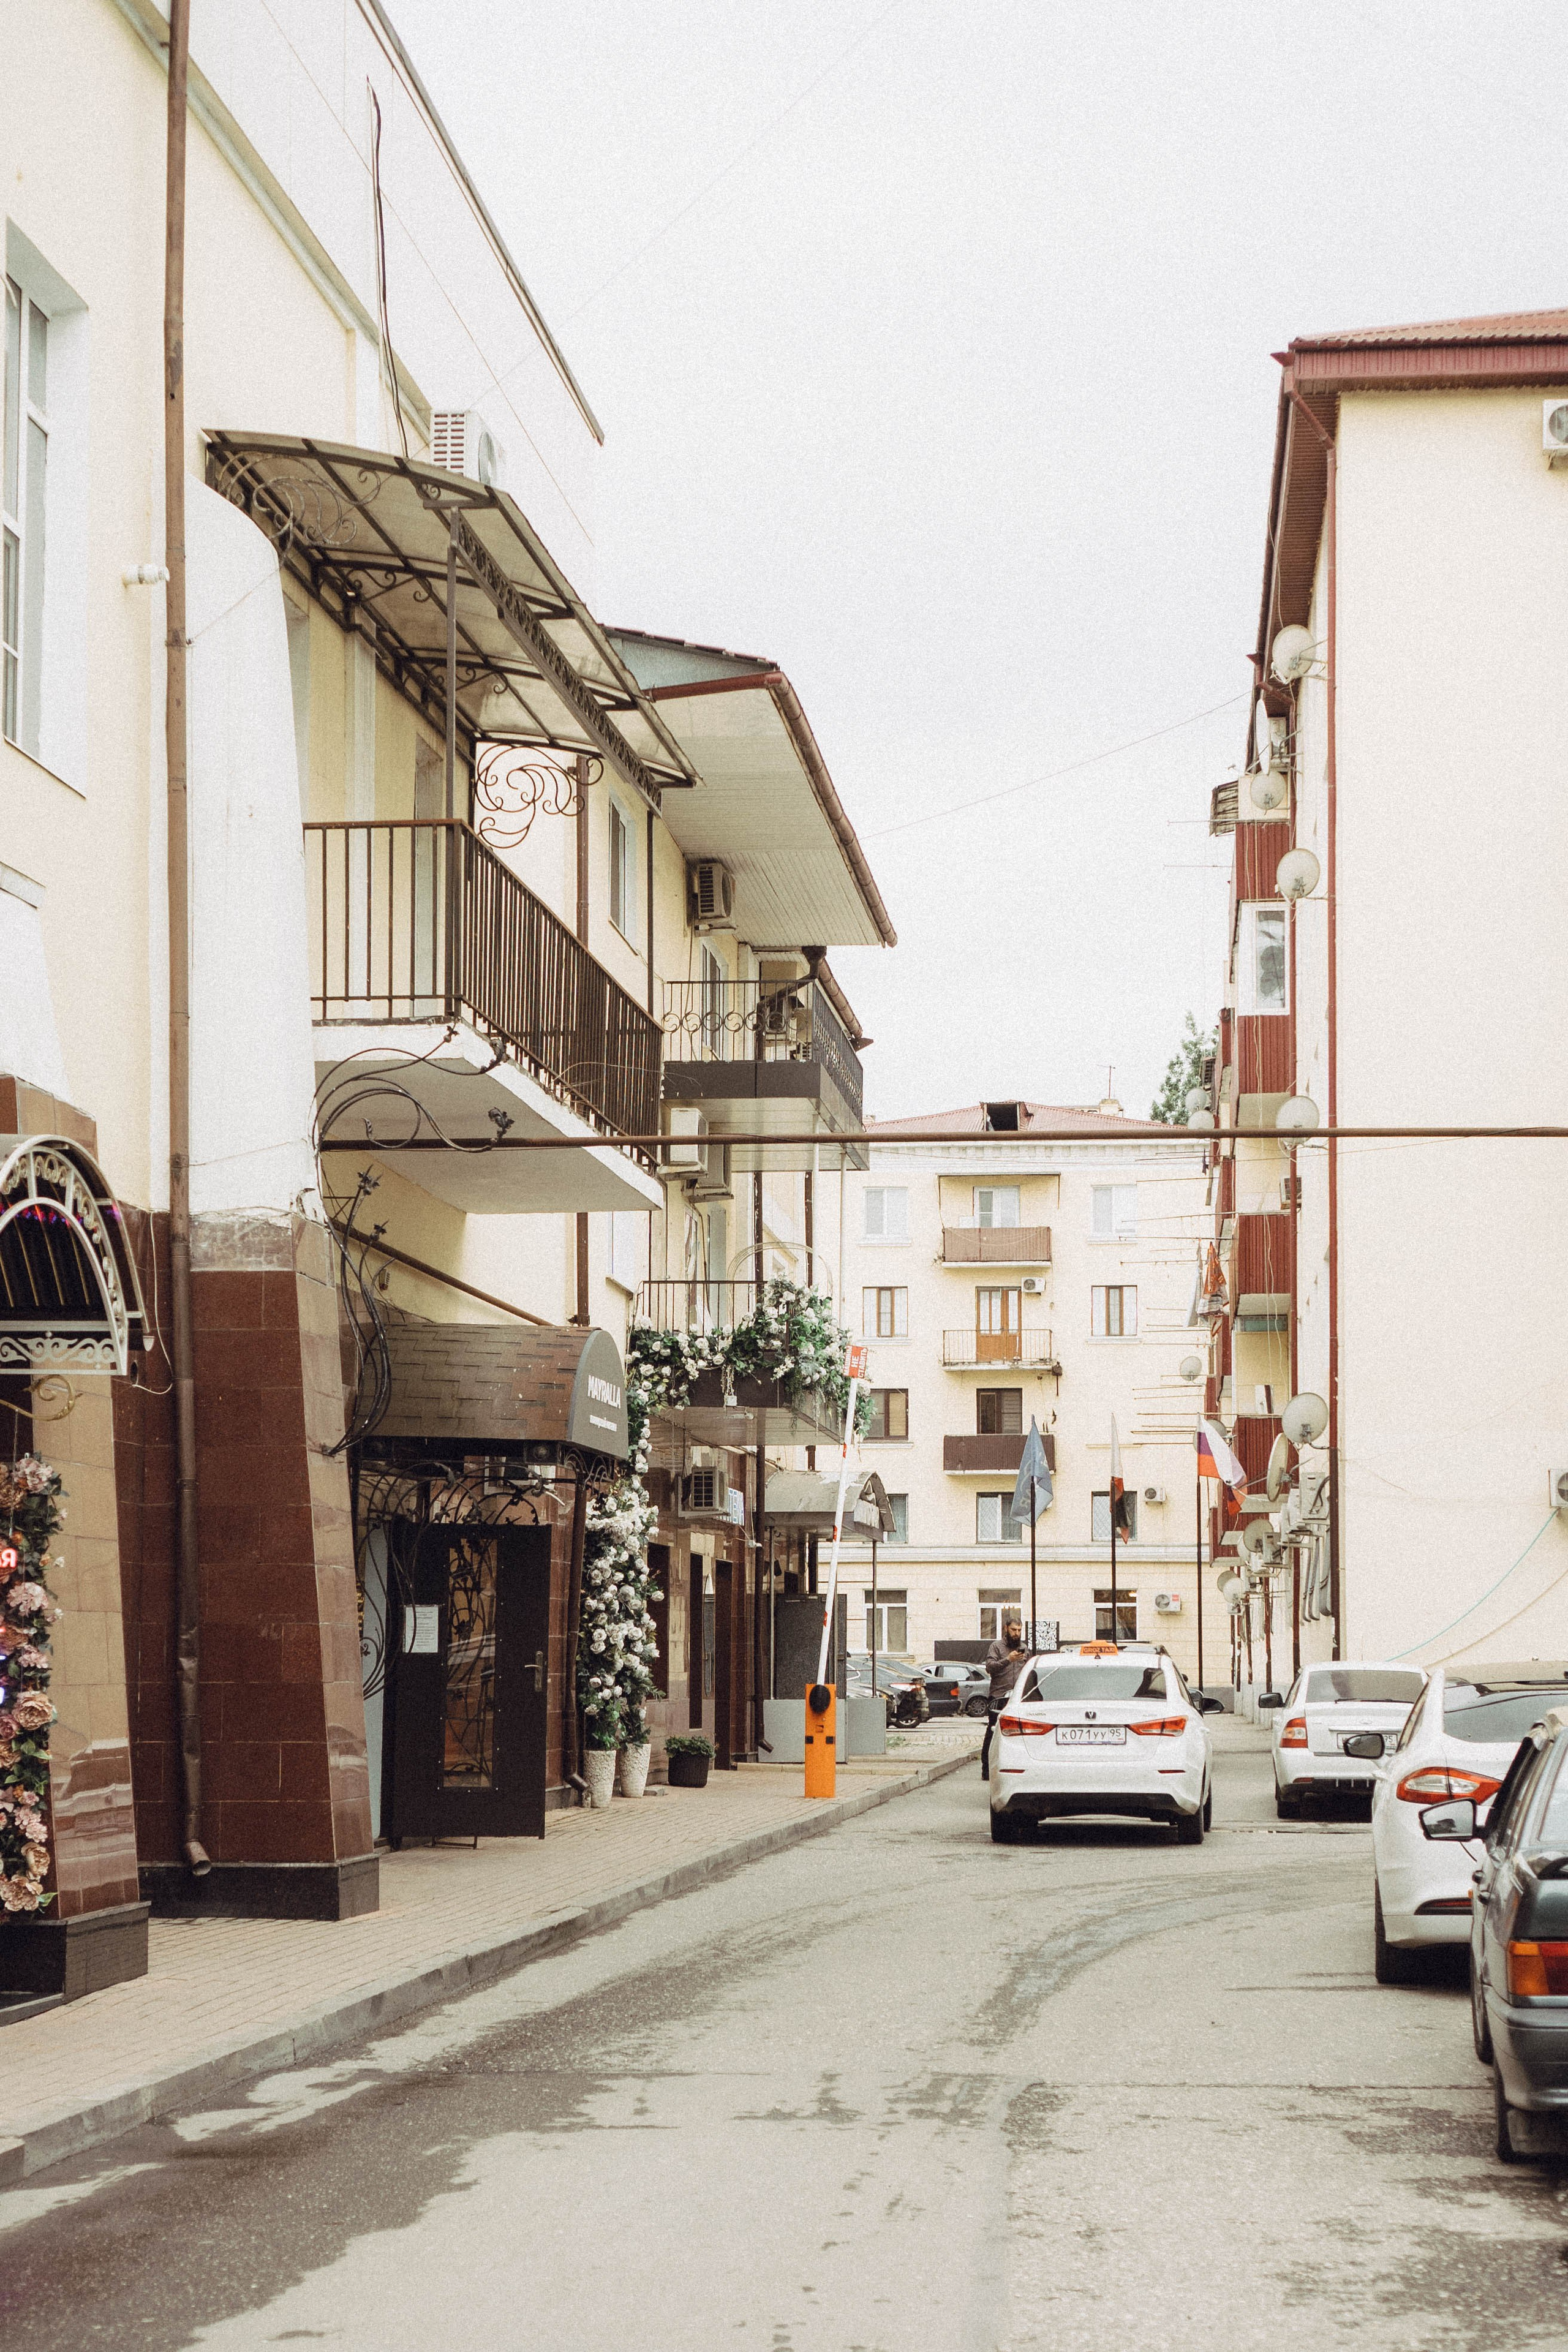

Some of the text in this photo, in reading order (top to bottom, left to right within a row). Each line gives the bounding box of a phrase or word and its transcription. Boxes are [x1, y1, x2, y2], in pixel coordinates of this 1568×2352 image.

[851, 1355, 859, 1368] НЕ
[858, 1348, 867, 1378] СТАВИТЬ
[587, 1374, 621, 1409] MAYRALLA
[1110, 1728, 1121, 1737] 95
